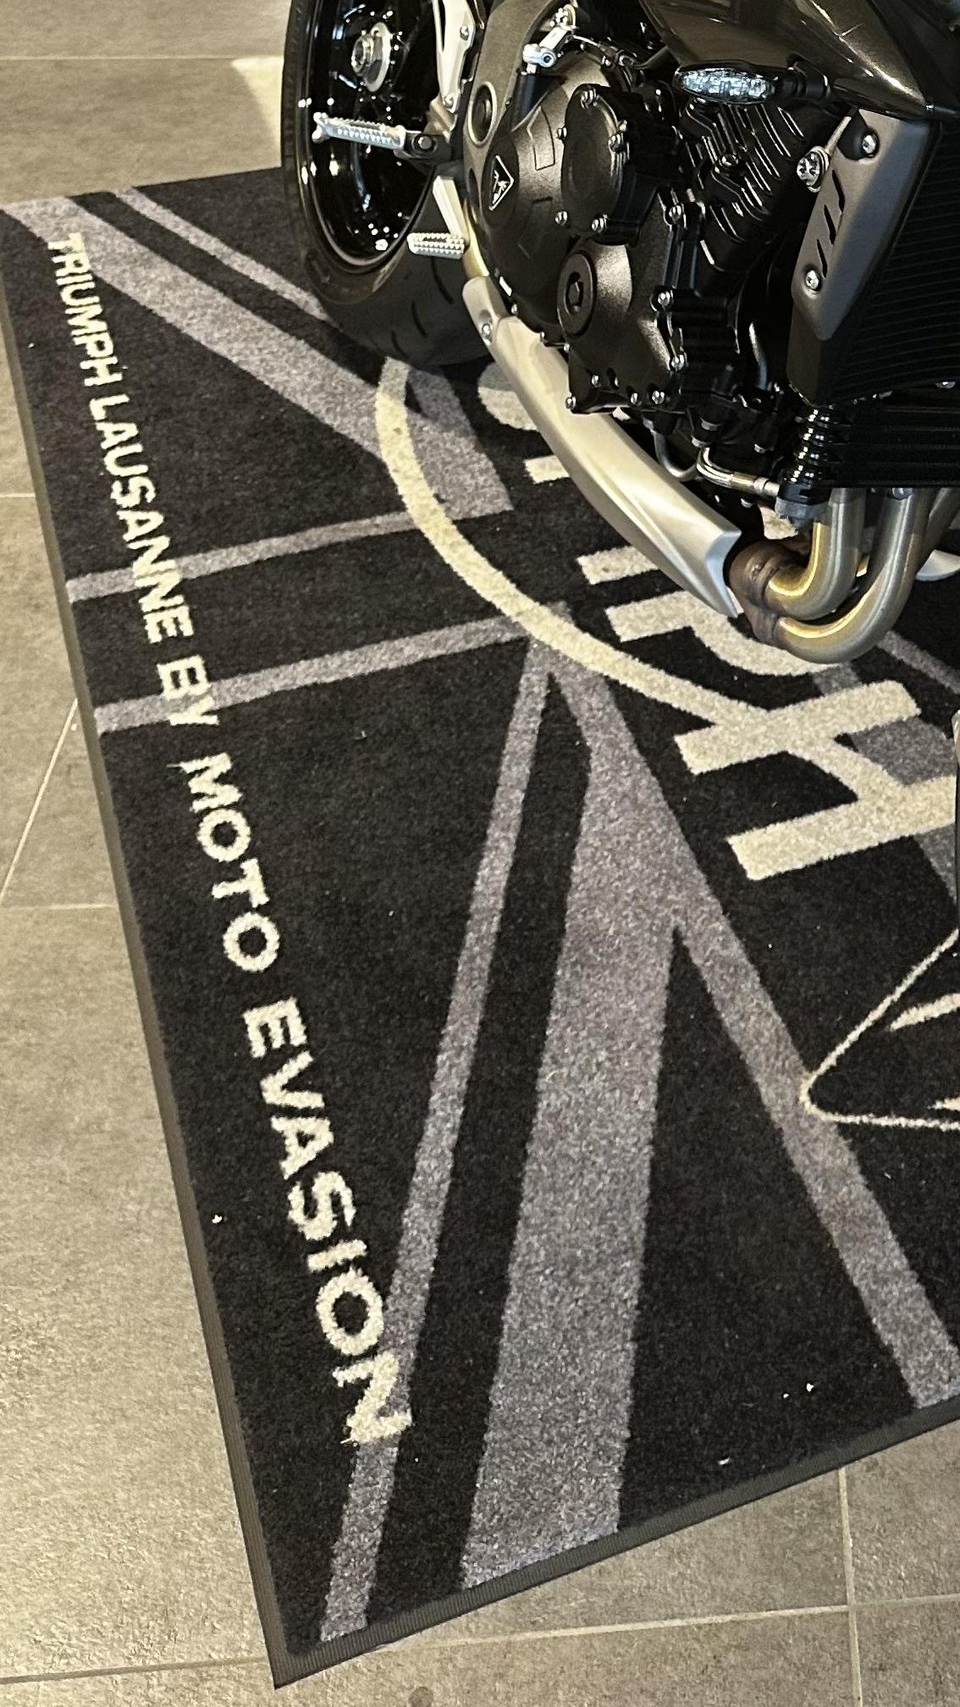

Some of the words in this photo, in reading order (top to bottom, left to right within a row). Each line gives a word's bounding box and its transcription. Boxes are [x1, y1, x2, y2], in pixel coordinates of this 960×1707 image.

[47, 232, 123, 387] TRIUMPH
[88, 393, 195, 644] LAUSANNE
[156, 655, 220, 727] BY
[176, 751, 281, 973] MOTO
[242, 996, 413, 1444] EVASION
